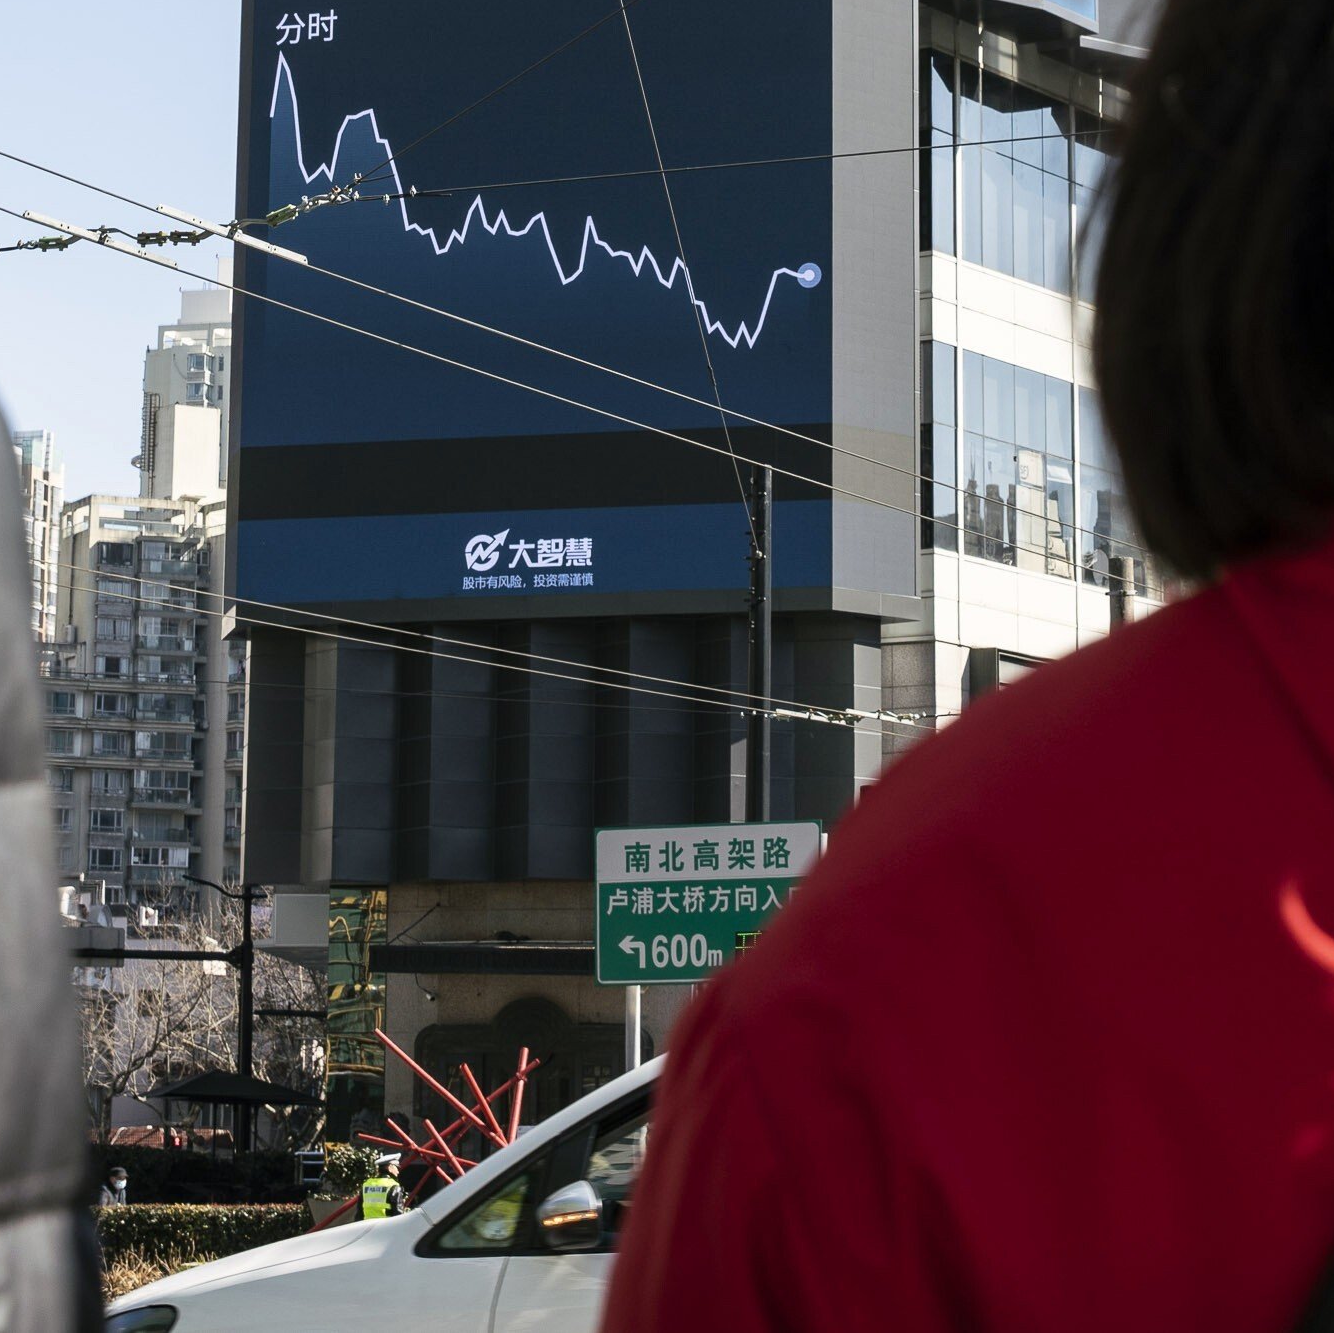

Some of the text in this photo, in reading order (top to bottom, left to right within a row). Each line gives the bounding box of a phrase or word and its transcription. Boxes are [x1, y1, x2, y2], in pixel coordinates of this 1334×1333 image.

[275, 9, 338, 46] 分时
[508, 537, 593, 569] 大智慧
[462, 572, 594, 590] 股市有风险，投资需谨慎
[624, 836, 791, 873] 南北高架路
[651, 933, 723, 968] 600m
